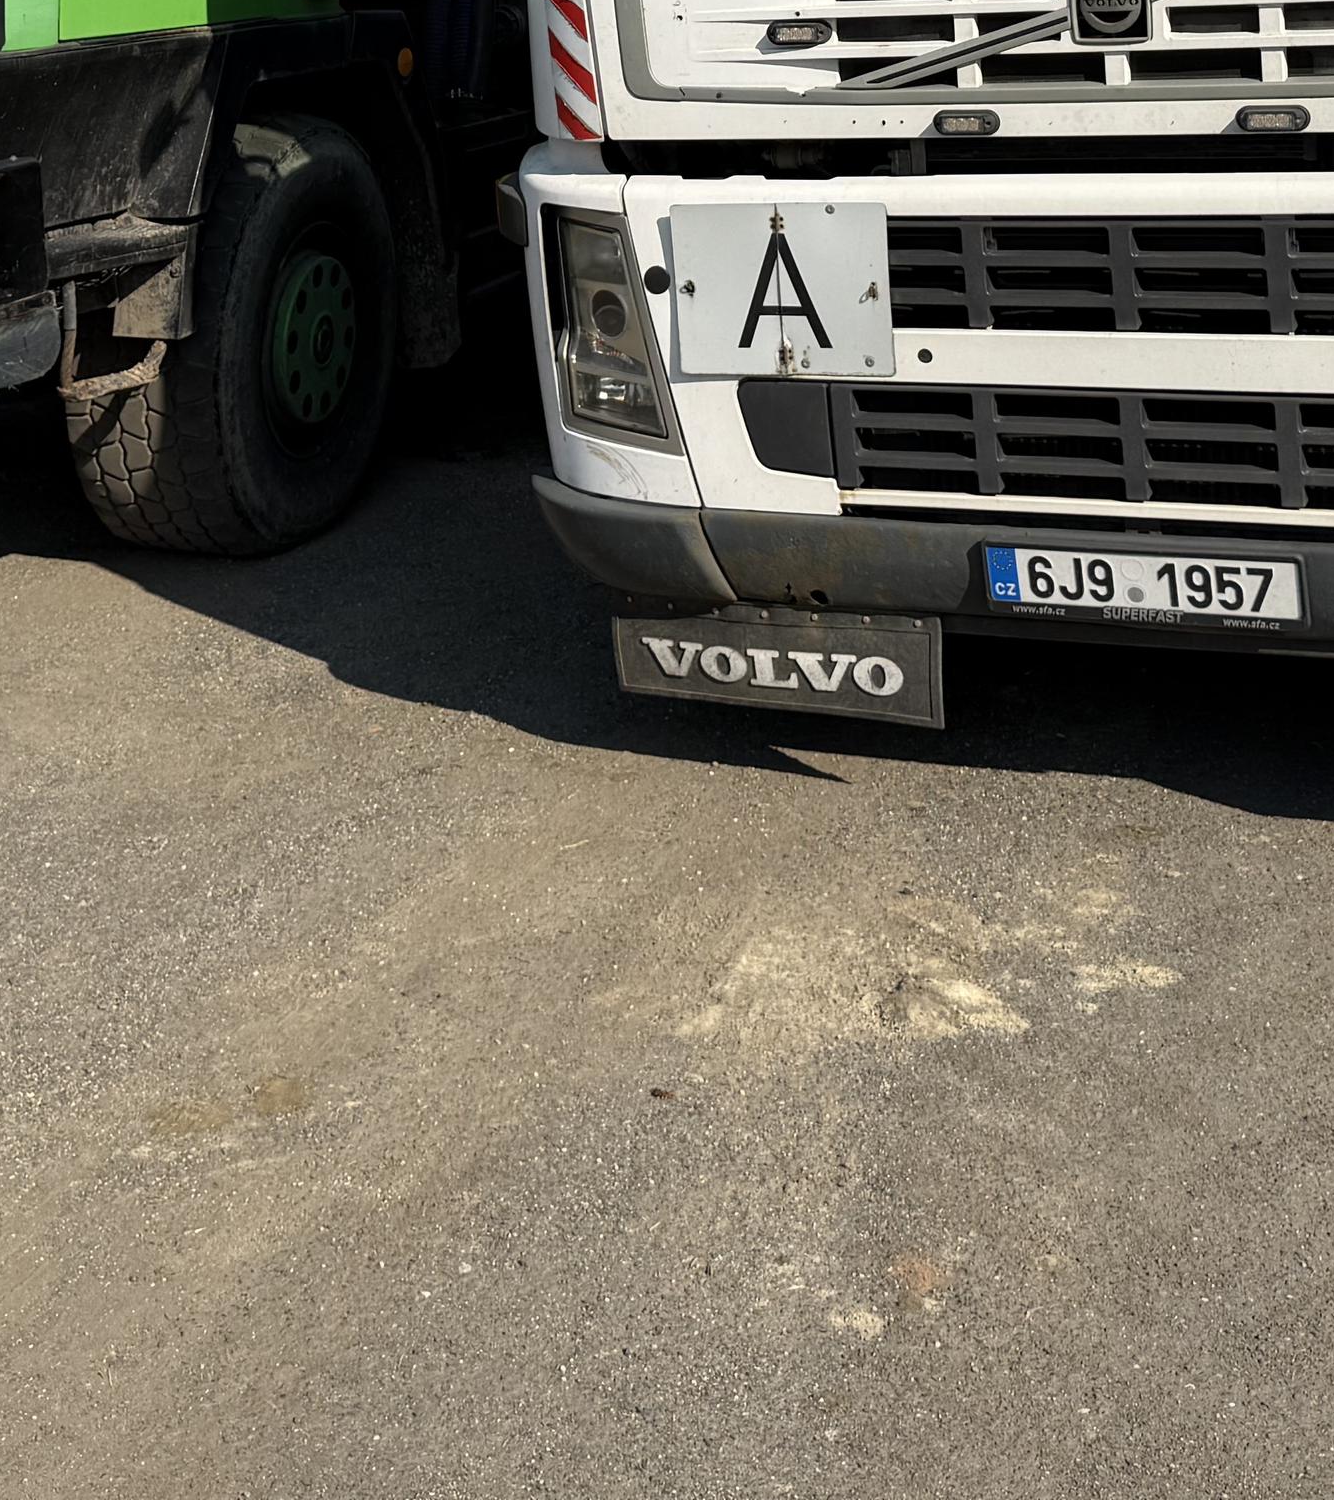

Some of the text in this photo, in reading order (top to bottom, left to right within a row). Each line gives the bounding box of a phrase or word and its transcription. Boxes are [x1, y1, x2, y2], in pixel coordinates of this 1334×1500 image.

[737, 231, 833, 349] A
[995, 582, 1017, 596] CZ
[1027, 555, 1274, 613] 6J9 1957
[1012, 603, 1066, 616] www.sfa.cz
[1102, 606, 1184, 624] SUPERFAST
[1222, 617, 1281, 630] www.sfa.cz
[640, 636, 905, 698] VOLVO
